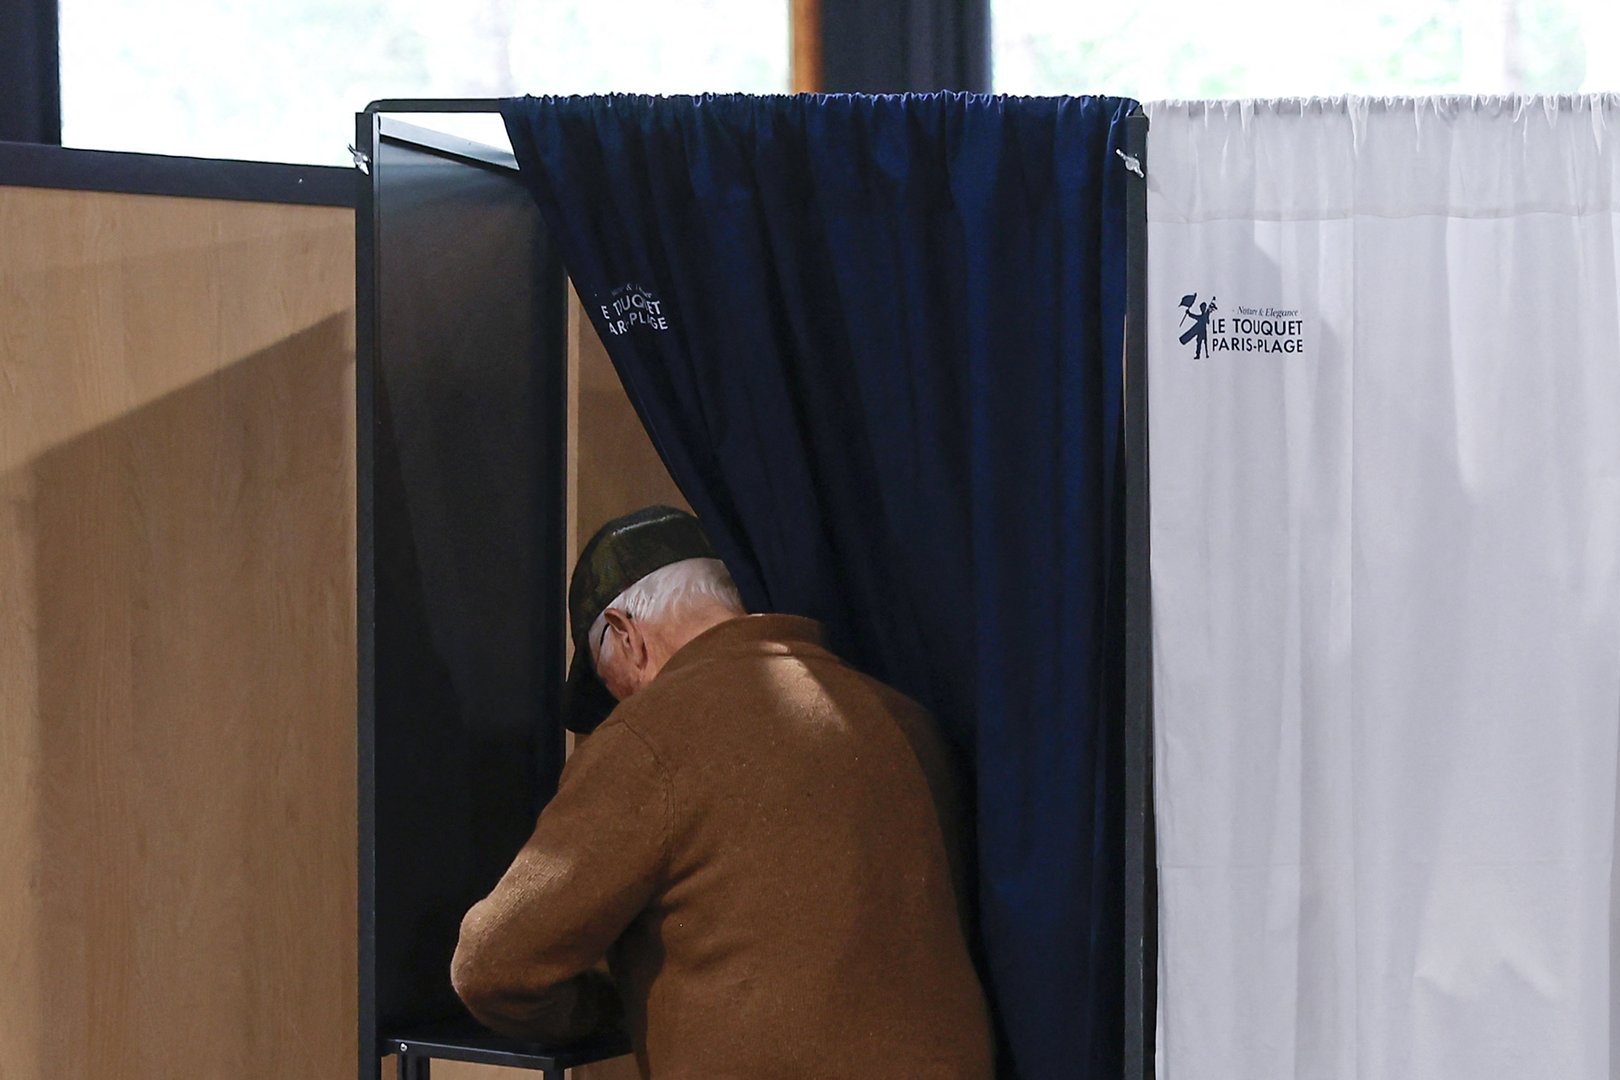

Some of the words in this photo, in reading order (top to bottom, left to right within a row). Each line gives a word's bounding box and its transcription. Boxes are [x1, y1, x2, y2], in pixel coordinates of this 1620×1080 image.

[601, 305, 610, 320] E
[1265, 308, 1298, 318] Elegance
[1212, 318, 1226, 334] LE
[1232, 318, 1303, 336] TOUQUET
[1212, 337, 1303, 353] PARIS-PLAGE
